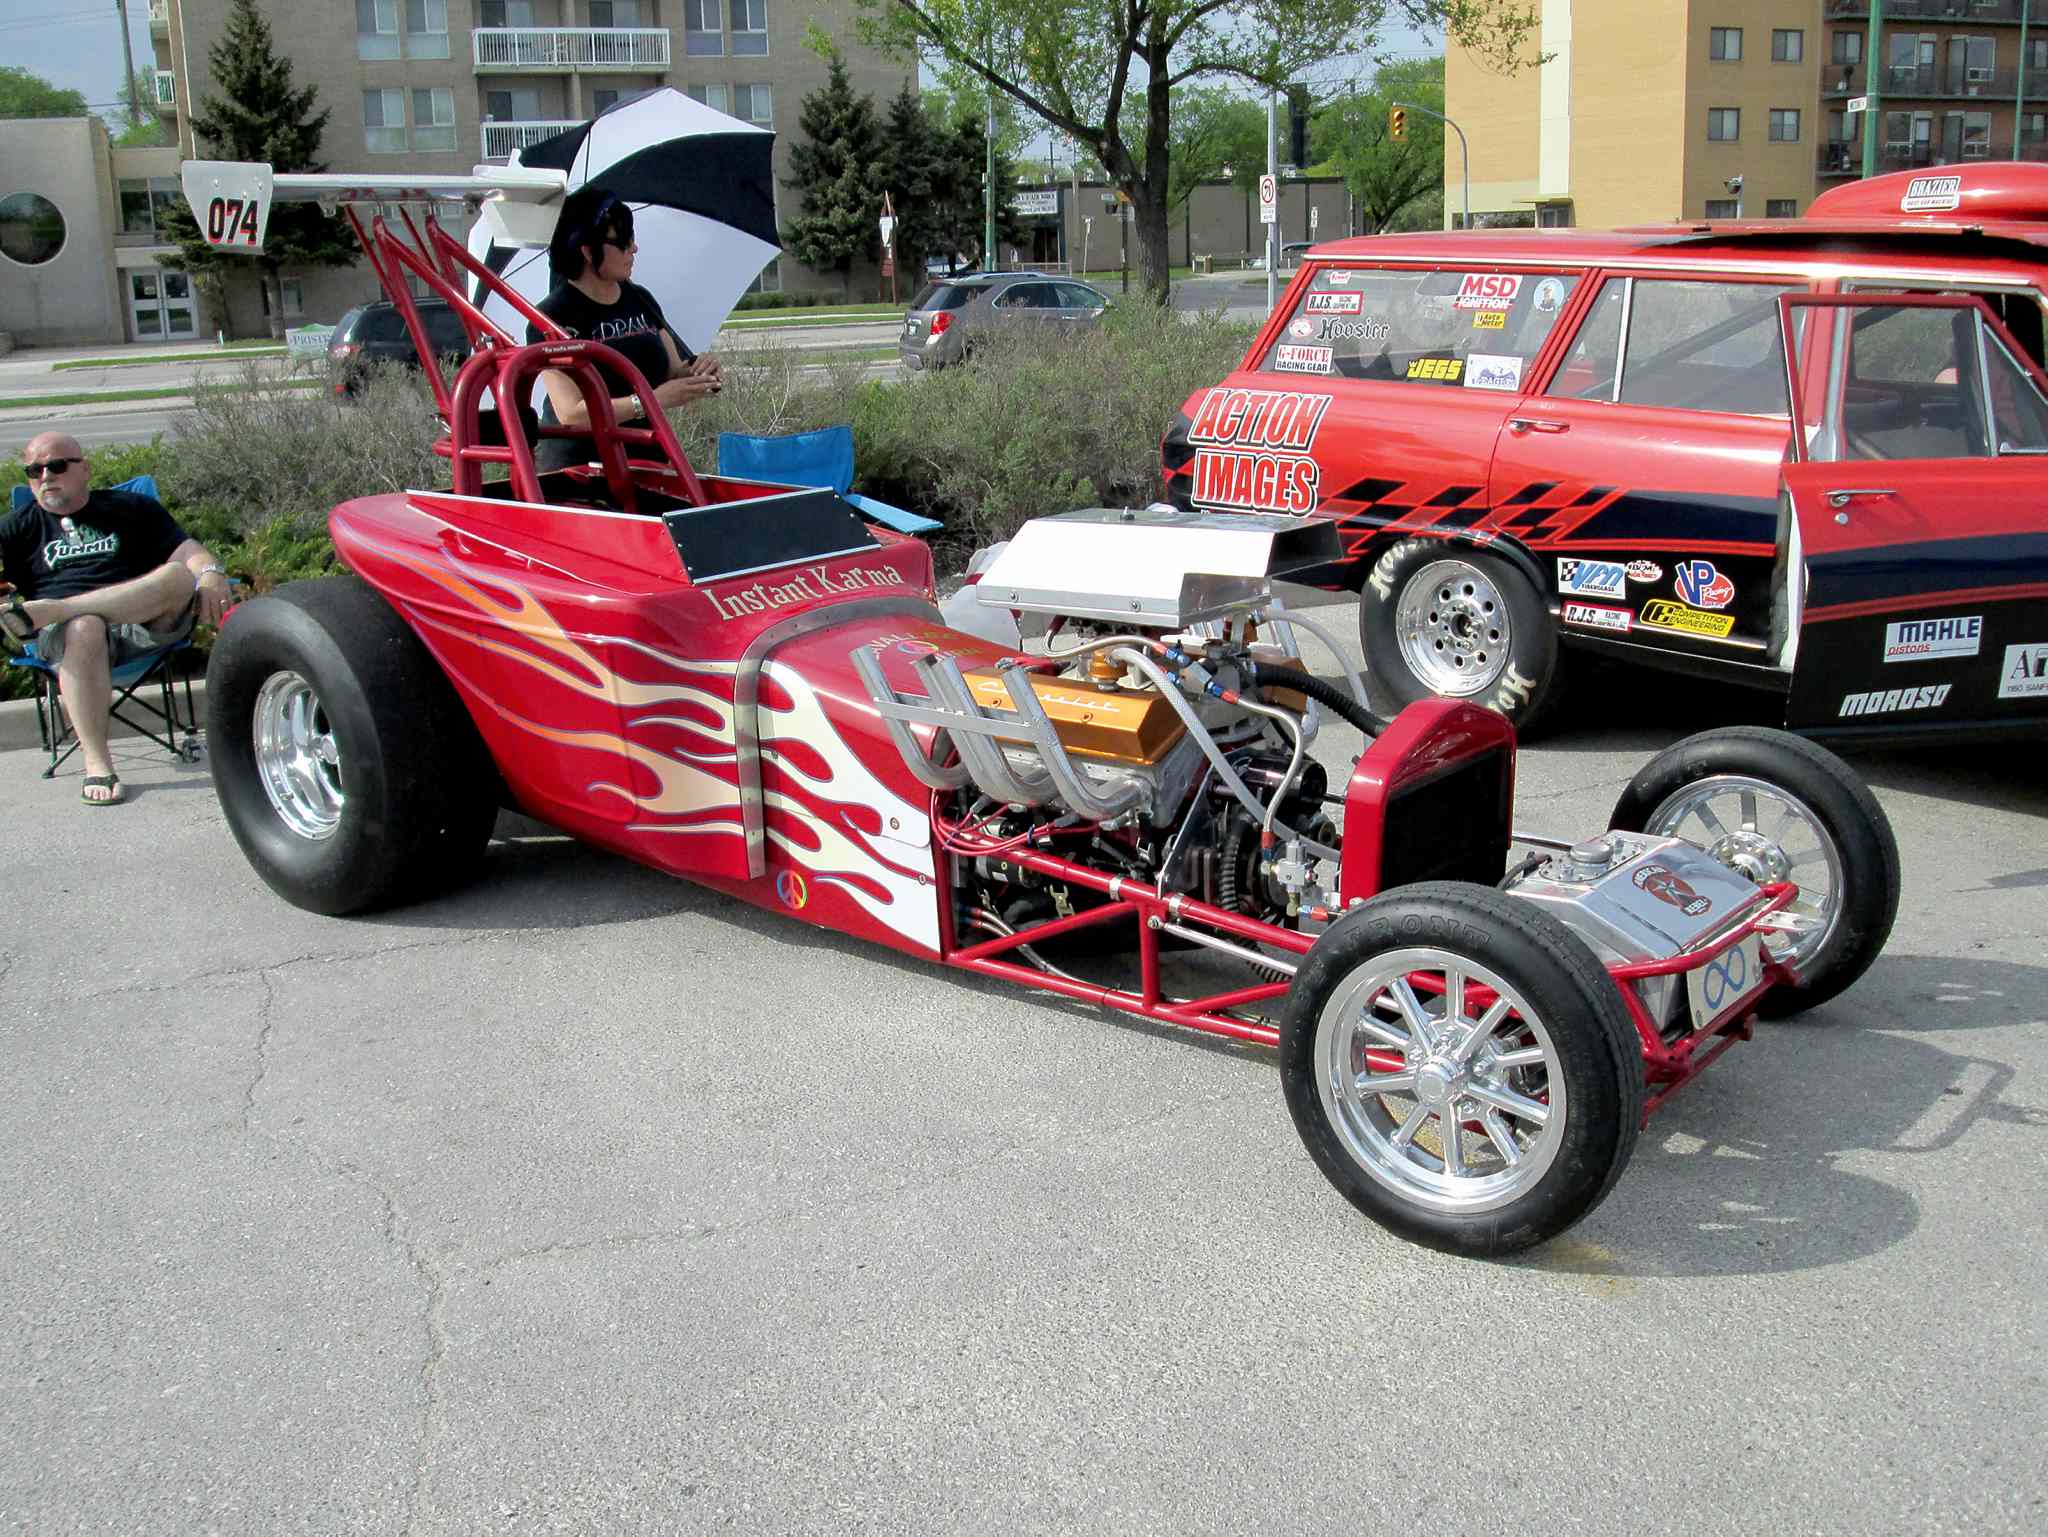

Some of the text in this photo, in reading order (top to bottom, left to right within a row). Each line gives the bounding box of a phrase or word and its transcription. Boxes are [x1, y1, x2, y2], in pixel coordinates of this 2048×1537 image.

[1910, 180, 1957, 197] BRAZIER
[208, 197, 258, 245] 074
[1461, 275, 1517, 297] MSD
[1316, 317, 1390, 340] Hoosier
[1278, 346, 1331, 362] G-FORCE
[1276, 360, 1328, 372] RACING GEAR
[1407, 358, 1463, 380] JEGS
[1190, 389, 1331, 450] ACTION
[1194, 451, 1318, 514] IMAGES
[702, 564, 904, 621] Instant Karma
[1675, 560, 1716, 607] VP
[1669, 615, 1726, 632] ENGINEERING
[1672, 609, 1729, 625] COMPETITION
[1898, 618, 1979, 643] MAHLE
[1887, 643, 1932, 657] pistons
[1838, 684, 1952, 717] MOROSO
